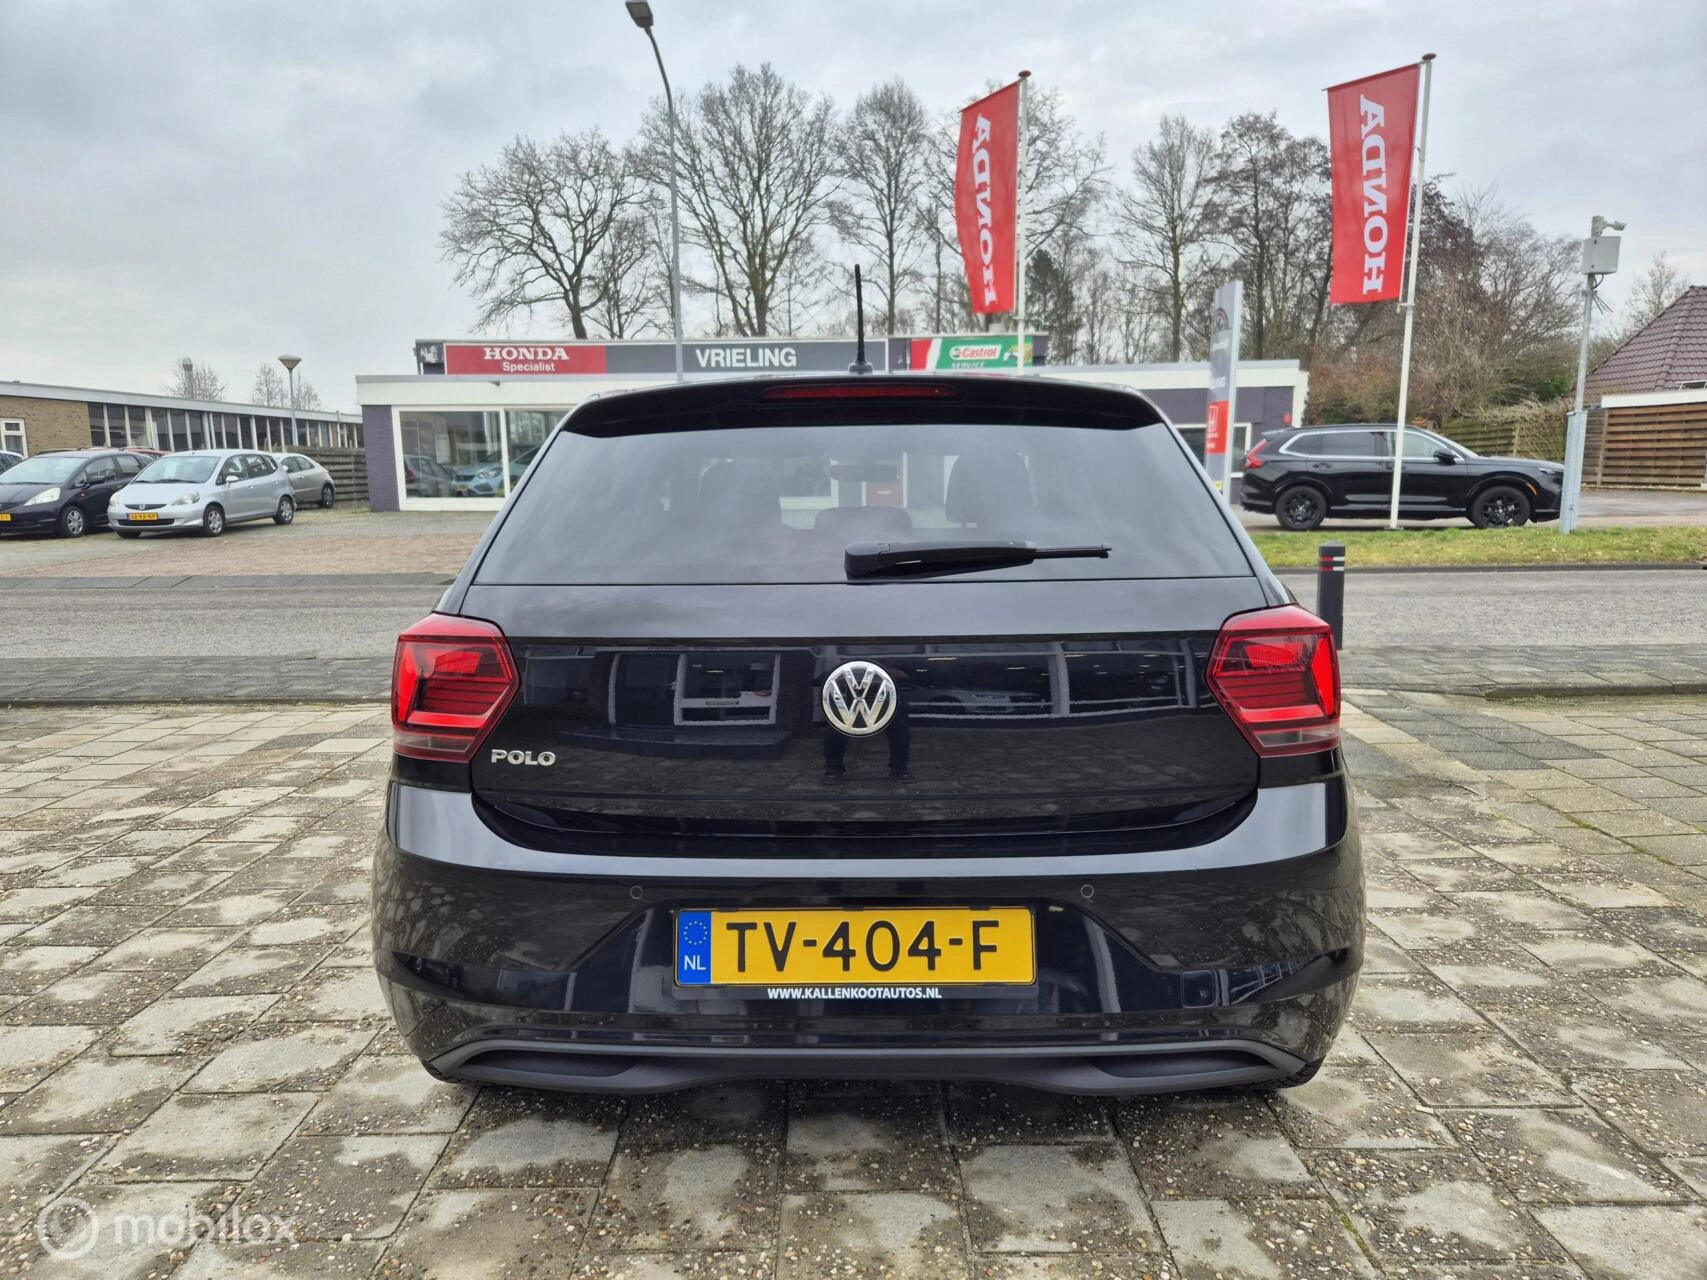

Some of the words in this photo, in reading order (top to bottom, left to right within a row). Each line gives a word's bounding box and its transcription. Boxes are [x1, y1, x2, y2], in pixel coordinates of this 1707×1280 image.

[483, 347, 570, 361] HONDA
[695, 347, 797, 368] VRIELING
[960, 346, 998, 358] Castrol
[502, 361, 556, 373] Specialist
[490, 748, 557, 767] POLO
[683, 954, 707, 971] NL
[726, 920, 1000, 973] TV-404-F
[767, 987, 943, 999] WWW.KALLENKOOTAUTOS.NL
